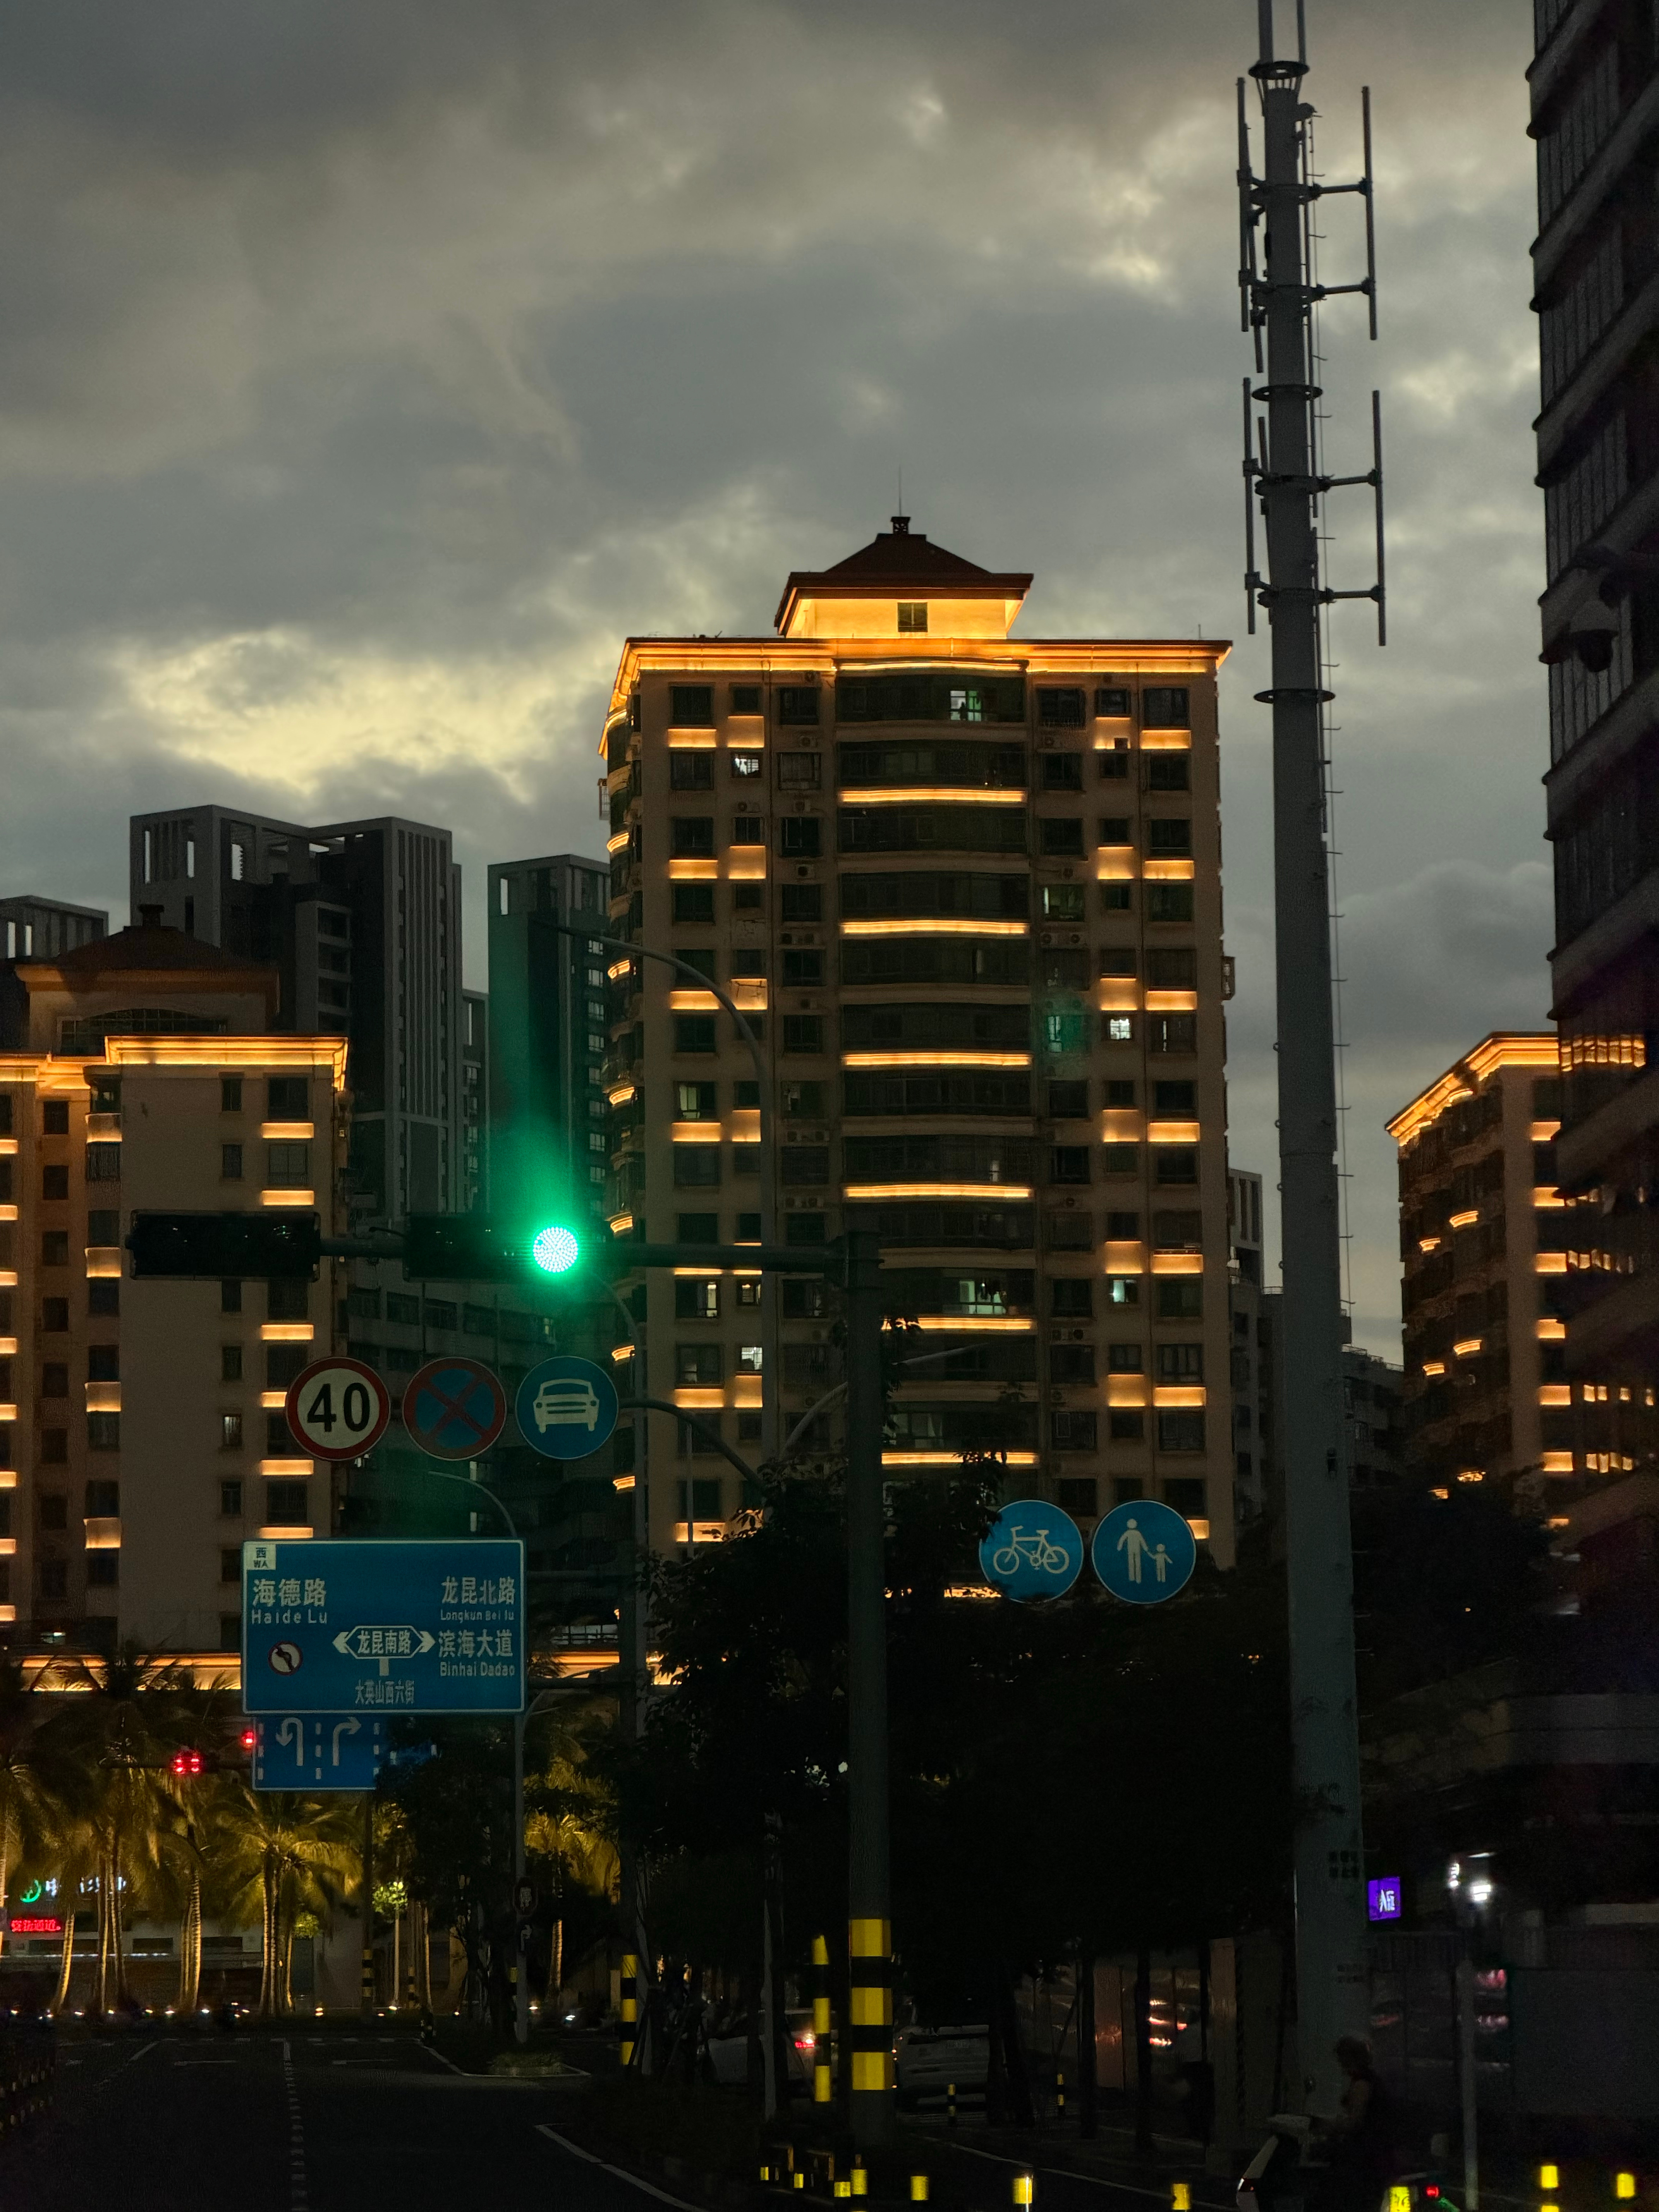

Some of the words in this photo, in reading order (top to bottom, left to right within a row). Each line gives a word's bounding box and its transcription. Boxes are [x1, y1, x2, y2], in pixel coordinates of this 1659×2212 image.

[307, 1382, 370, 1432] 40
[256, 1547, 267, 1559] 西
[252, 1578, 326, 1607] 海德路
[441, 1576, 515, 1605] 龙昆北路
[251, 1609, 302, 1624] Haide
[308, 1609, 327, 1624] Lu
[440, 1609, 483, 1623] Longkun
[357, 1629, 411, 1654] 龙昆南路
[438, 1628, 514, 1658] 滨海大道
[440, 1661, 477, 1677] Binhai
[480, 1661, 515, 1677] Dadao
